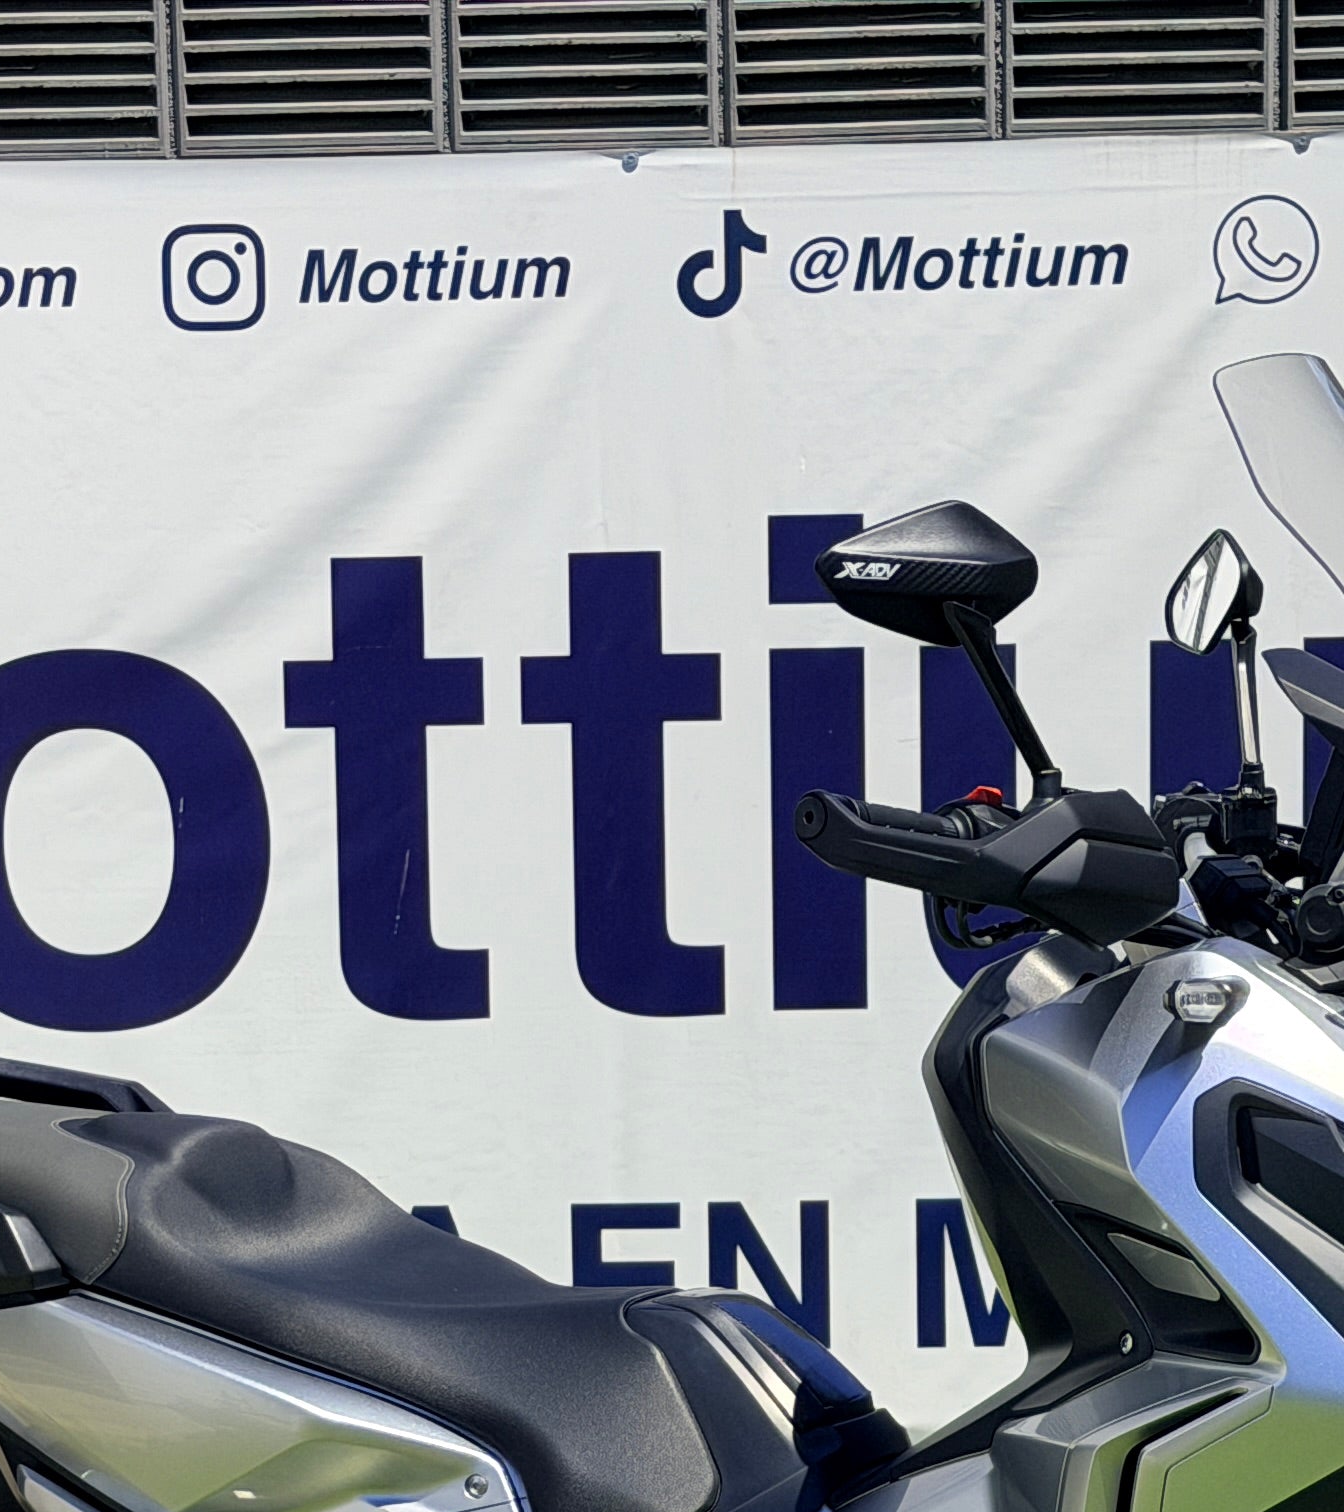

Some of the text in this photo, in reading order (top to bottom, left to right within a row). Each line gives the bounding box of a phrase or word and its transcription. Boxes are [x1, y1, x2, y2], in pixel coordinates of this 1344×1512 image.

[299, 245, 571, 304] Mottium
[789, 232, 1129, 294] @Mottium
[834, 561, 902, 580] X-ADV
